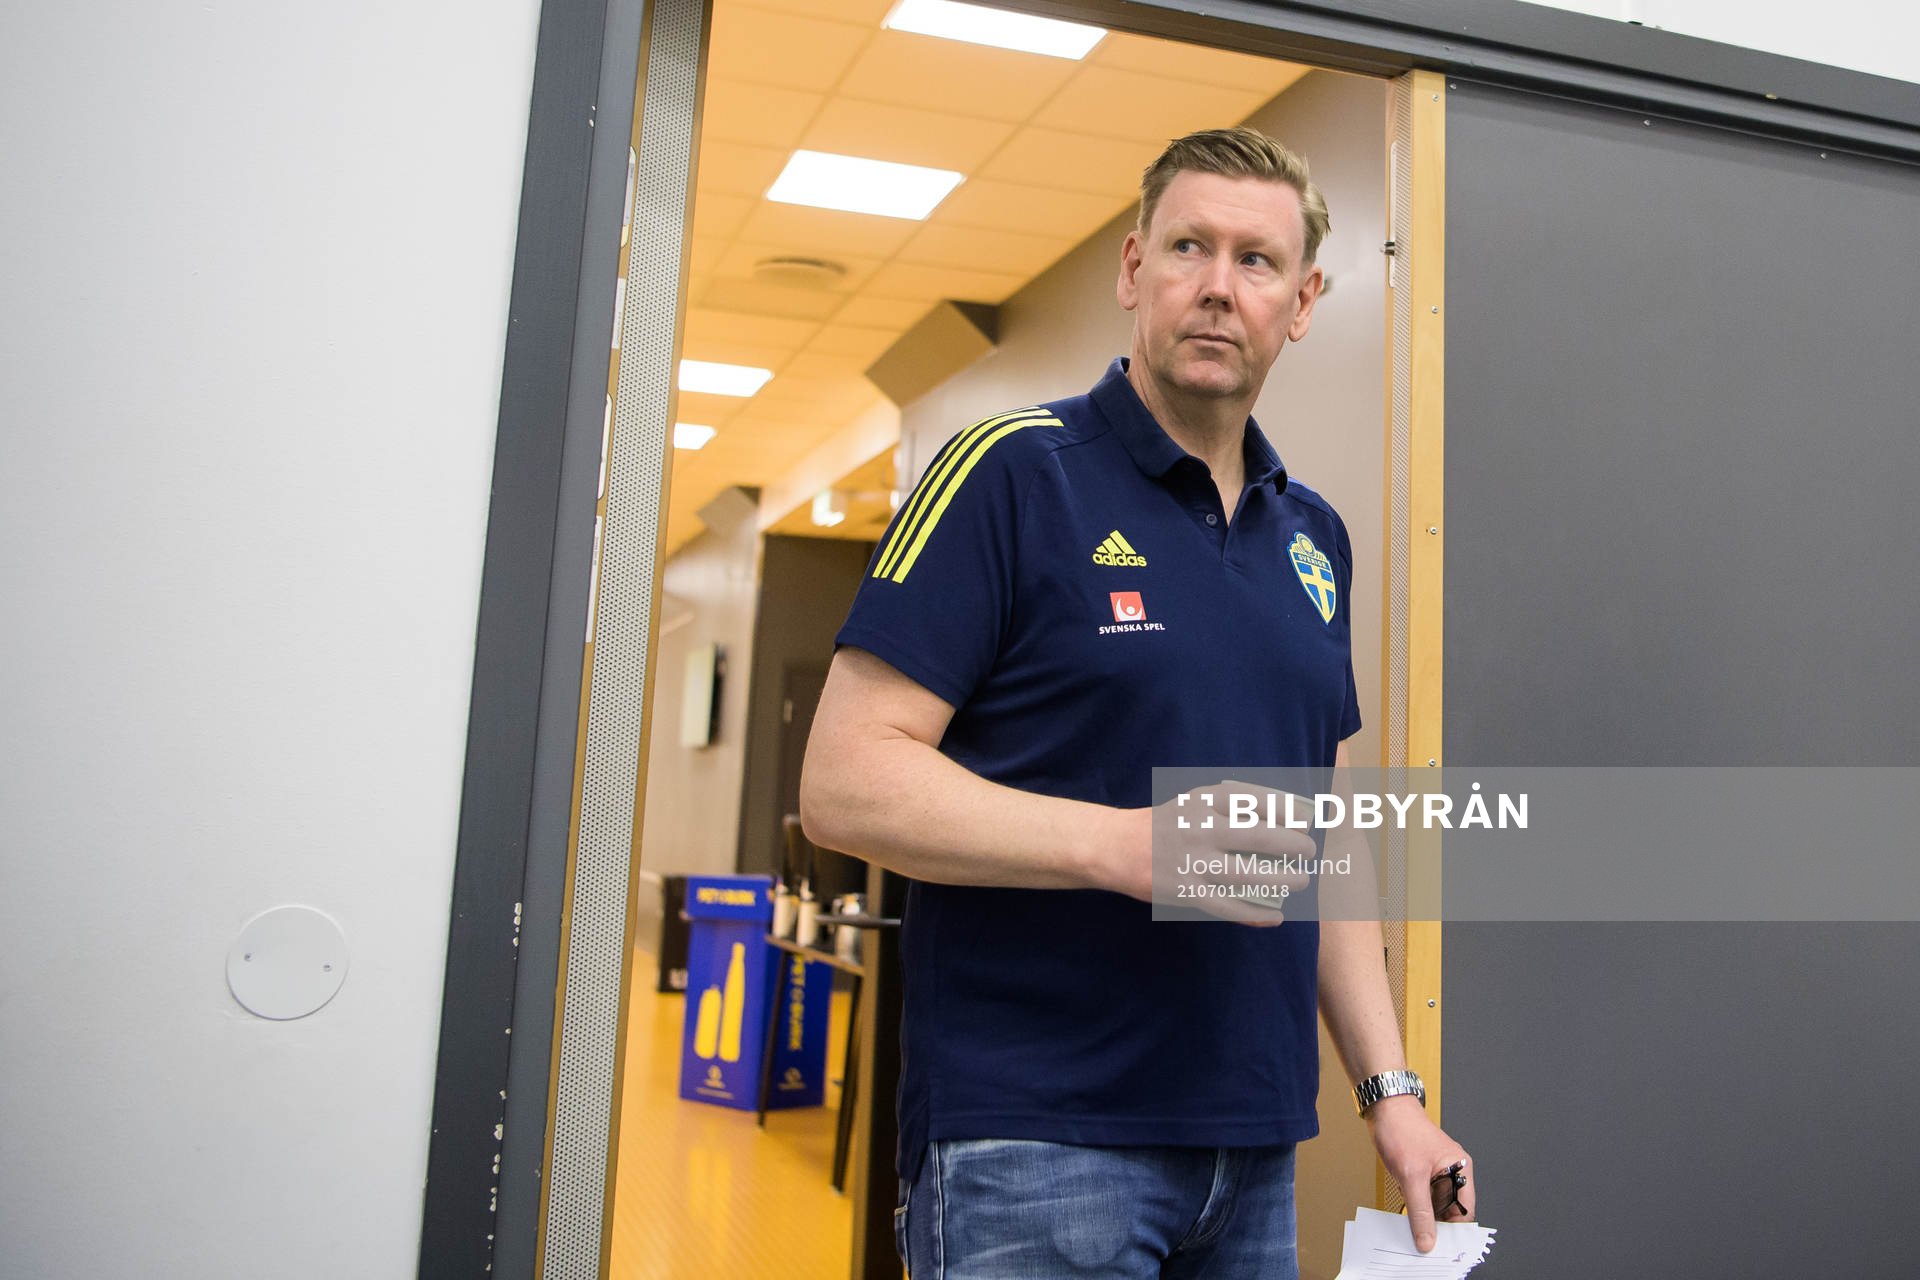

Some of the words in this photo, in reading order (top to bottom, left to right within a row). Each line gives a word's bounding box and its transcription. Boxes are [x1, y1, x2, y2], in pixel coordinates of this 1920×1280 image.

[1092, 552, 1147, 567] adidas
[1099, 624, 1142, 634] SVENSKA
[1144, 623, 1166, 631] SPEL
